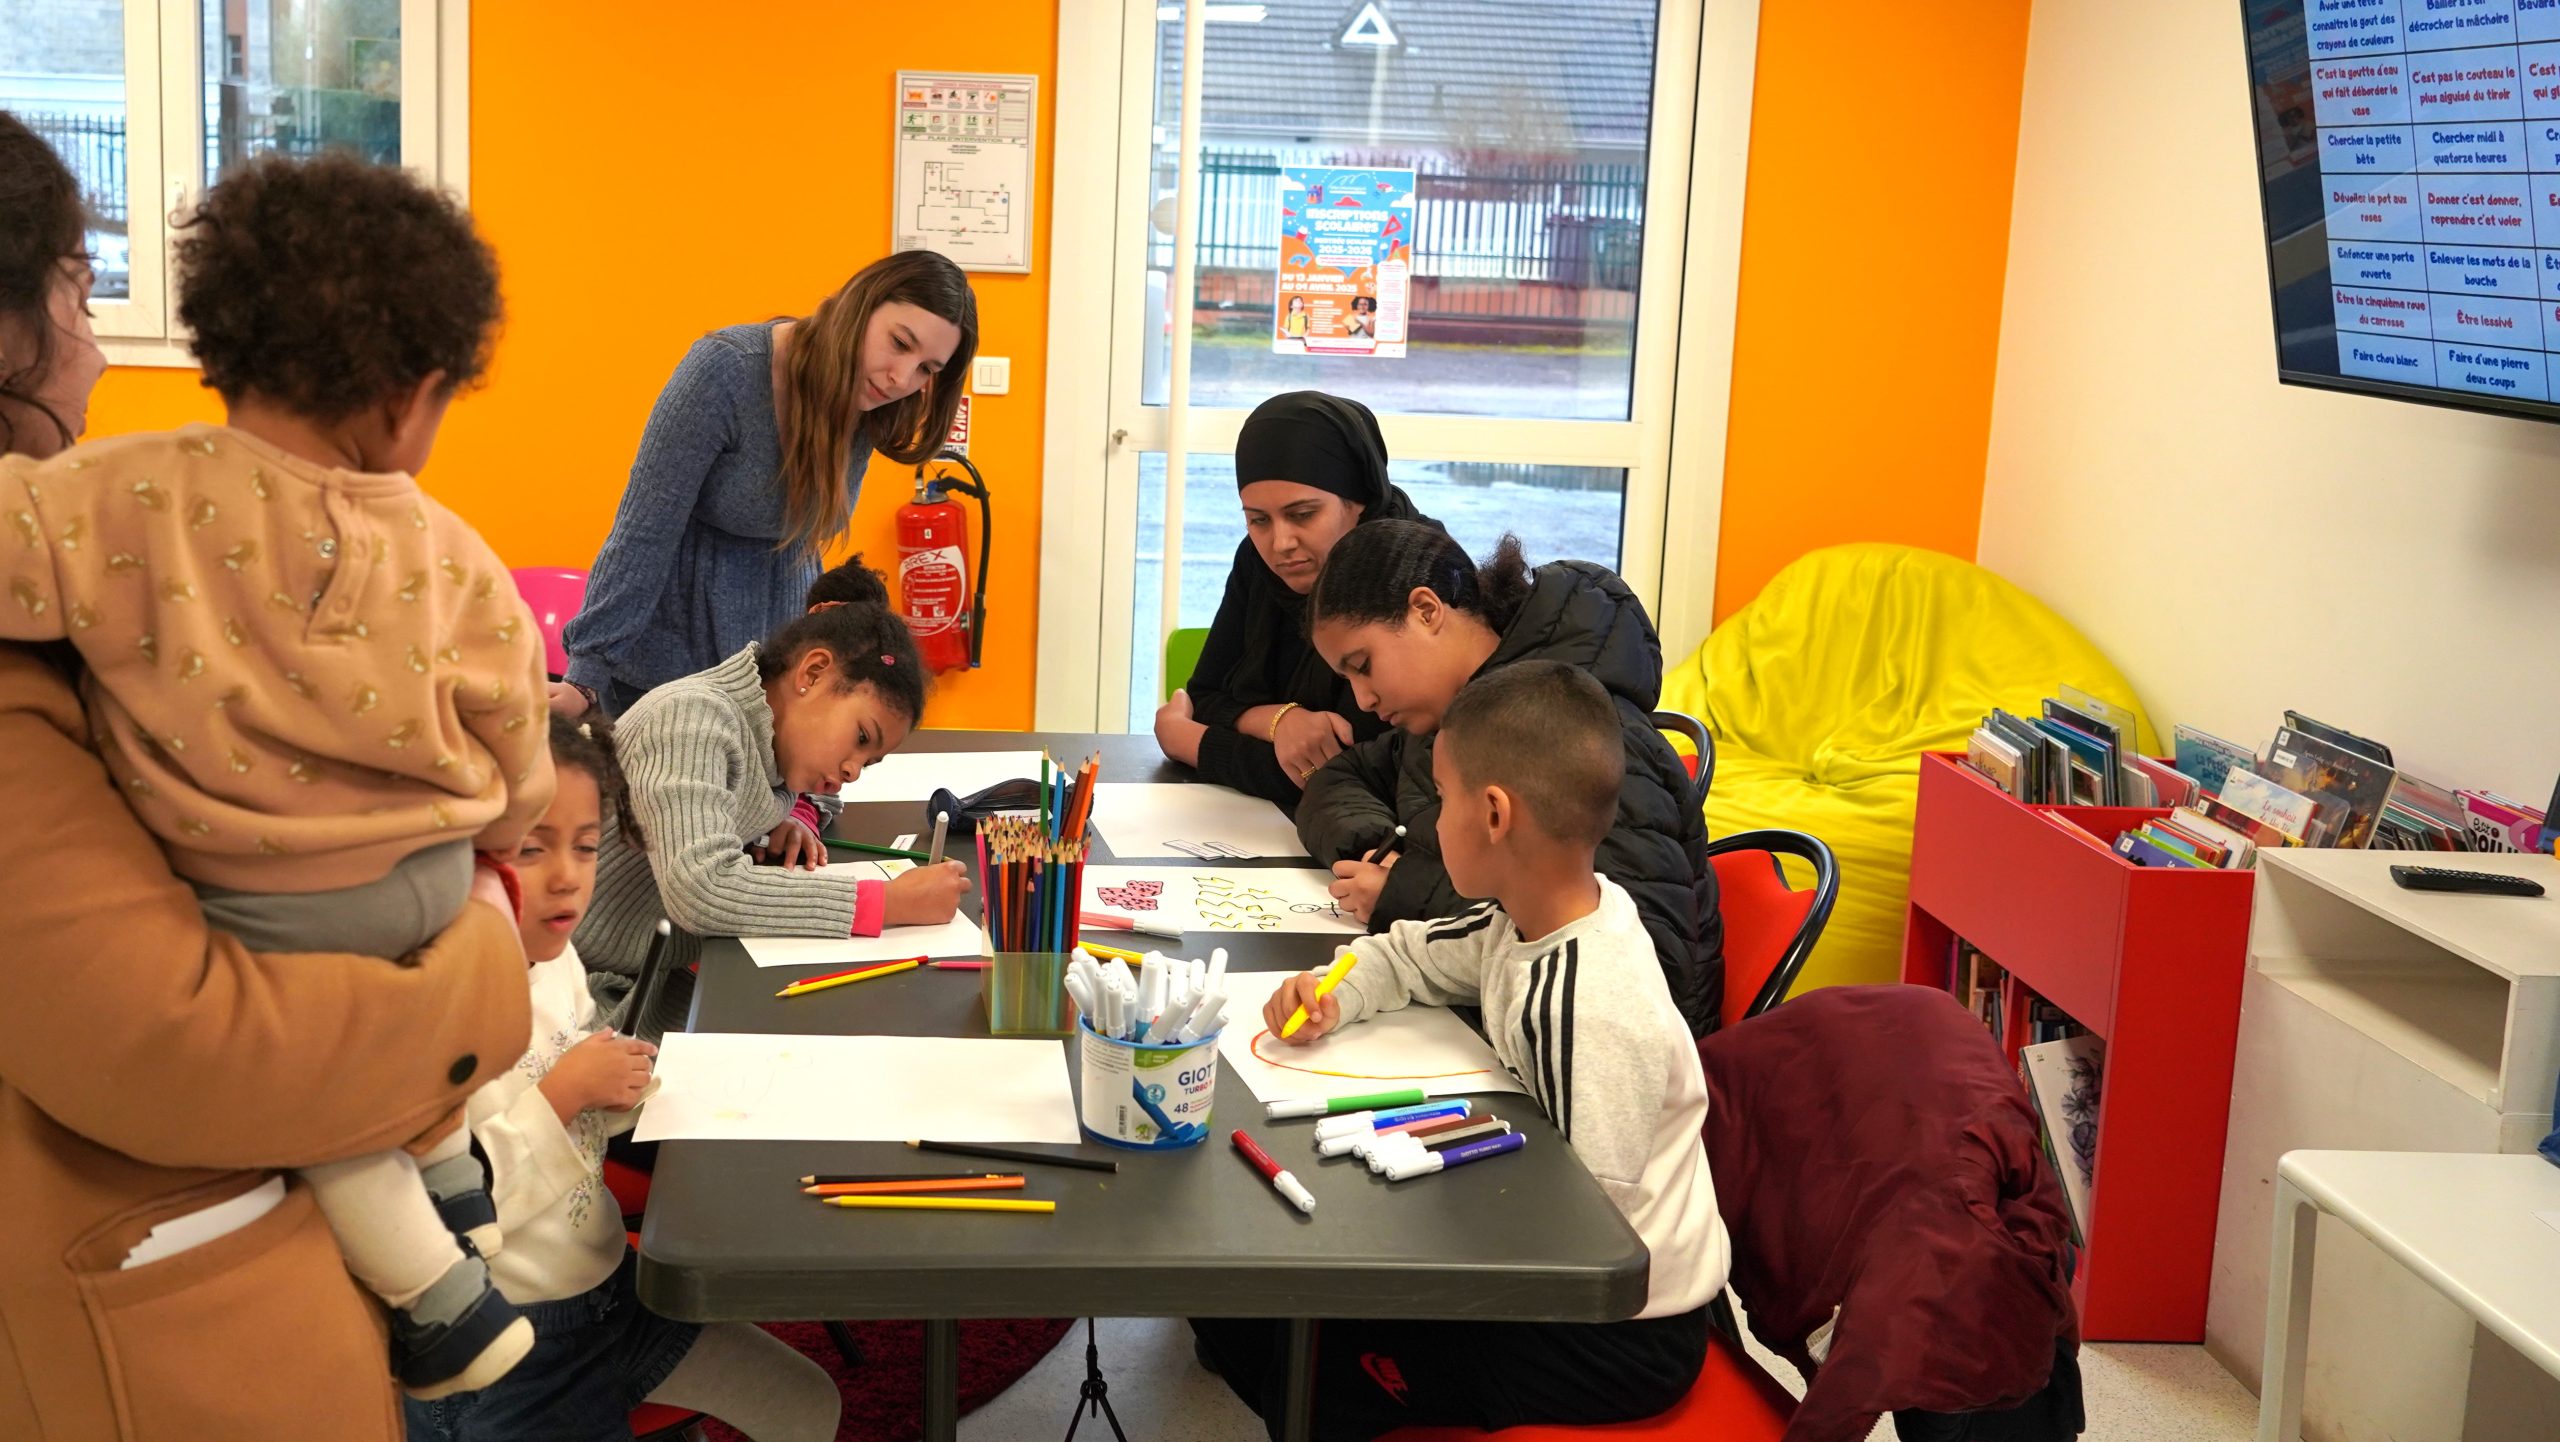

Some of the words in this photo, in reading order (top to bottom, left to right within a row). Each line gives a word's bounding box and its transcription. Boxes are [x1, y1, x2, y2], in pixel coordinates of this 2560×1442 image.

[2341, 0, 2355, 9] une
[2350, 17, 2358, 28] le
[2381, 13, 2395, 25] des
[2408, 18, 2453, 32] décrocher
[2455, 16, 2464, 28] la
[2466, 12, 2509, 27] mâchoire
[2316, 39, 2346, 51] crayons
[2348, 36, 2358, 47] de
[2360, 34, 2394, 47] couleurs
[2316, 67, 2337, 80] C'est
[2338, 67, 2346, 78] la
[2347, 66, 2375, 80] goutte
[2377, 63, 2399, 76] d'eau
[2412, 70, 2436, 84] C'est
[2438, 72, 2453, 85] pas
[2455, 69, 2463, 81] le
[2466, 68, 2504, 81] couteau
[2506, 66, 2515, 78] le
[2529, 62, 2556, 76] C'est
[2322, 87, 2334, 100] qui
[2335, 86, 2350, 98] fait
[2352, 84, 2388, 97] déborder
[2389, 84, 2398, 95] le
[2420, 92, 2437, 106] plus
[2440, 90, 2471, 104] aiguisé
[2473, 89, 2484, 101] du
[2486, 88, 2510, 101] tiroir
[2533, 85, 2548, 101] qui
[2351, 106, 2370, 116] vase
[2328, 134, 2364, 147] Chercher
[2366, 134, 2373, 145] la
[2375, 133, 2402, 148] petite
[2432, 131, 2474, 144] Chercher
[2476, 130, 2496, 143] midi
[2498, 130, 2504, 142] à
[2356, 153, 2376, 165] bête
[2433, 152, 2473, 166] quatorze
[2475, 151, 2507, 163] heures
[2333, 191, 2366, 203] Dévoiler
[2367, 192, 2376, 203] le
[2377, 193, 2391, 206] pot
[2393, 195, 2408, 204] aux
[2428, 192, 2460, 205] Donner
[2462, 193, 2485, 205] c'est
[2487, 194, 2522, 207] donner,
[2360, 214, 2382, 222] roses
[2431, 214, 2476, 227] reprendre
[2477, 214, 2496, 226] c'et
[2498, 215, 2522, 227] voler
[2337, 247, 2373, 260] Enfoncer
[2375, 252, 2390, 261] une
[2391, 251, 2415, 264] porte
[2430, 251, 2465, 265] Enlever
[2467, 254, 2480, 266] les
[2482, 256, 2505, 267] mots
[2507, 256, 2519, 268] de
[2522, 256, 2531, 269] la
[1281, 273, 1295, 281] DU
[1307, 274, 1345, 283] JANVIER
[2360, 269, 2392, 280] ouverte
[2464, 273, 2498, 287] bouche
[1309, 283, 1333, 292] AVRIL
[1335, 284, 1358, 292] 2025
[2336, 289, 2354, 305] Être
[2356, 295, 2363, 305] la
[2365, 296, 2405, 309] cinquième
[2406, 301, 2426, 311] roue
[2359, 314, 2369, 325] du
[2370, 316, 2405, 328] carrosse
[2457, 308, 2479, 326] Être
[2481, 315, 2513, 329] lessivé
[2353, 348, 2374, 362] Faire
[2376, 352, 2395, 364] chou
[2396, 354, 2419, 367] blanc
[2449, 349, 2473, 364] Faire
[2475, 353, 2499, 367] d'une
[2501, 356, 2530, 371] pierre
[2466, 372, 2487, 385] deux
[2488, 376, 2516, 391] coups
[1174, 1103, 1188, 1113] 48
